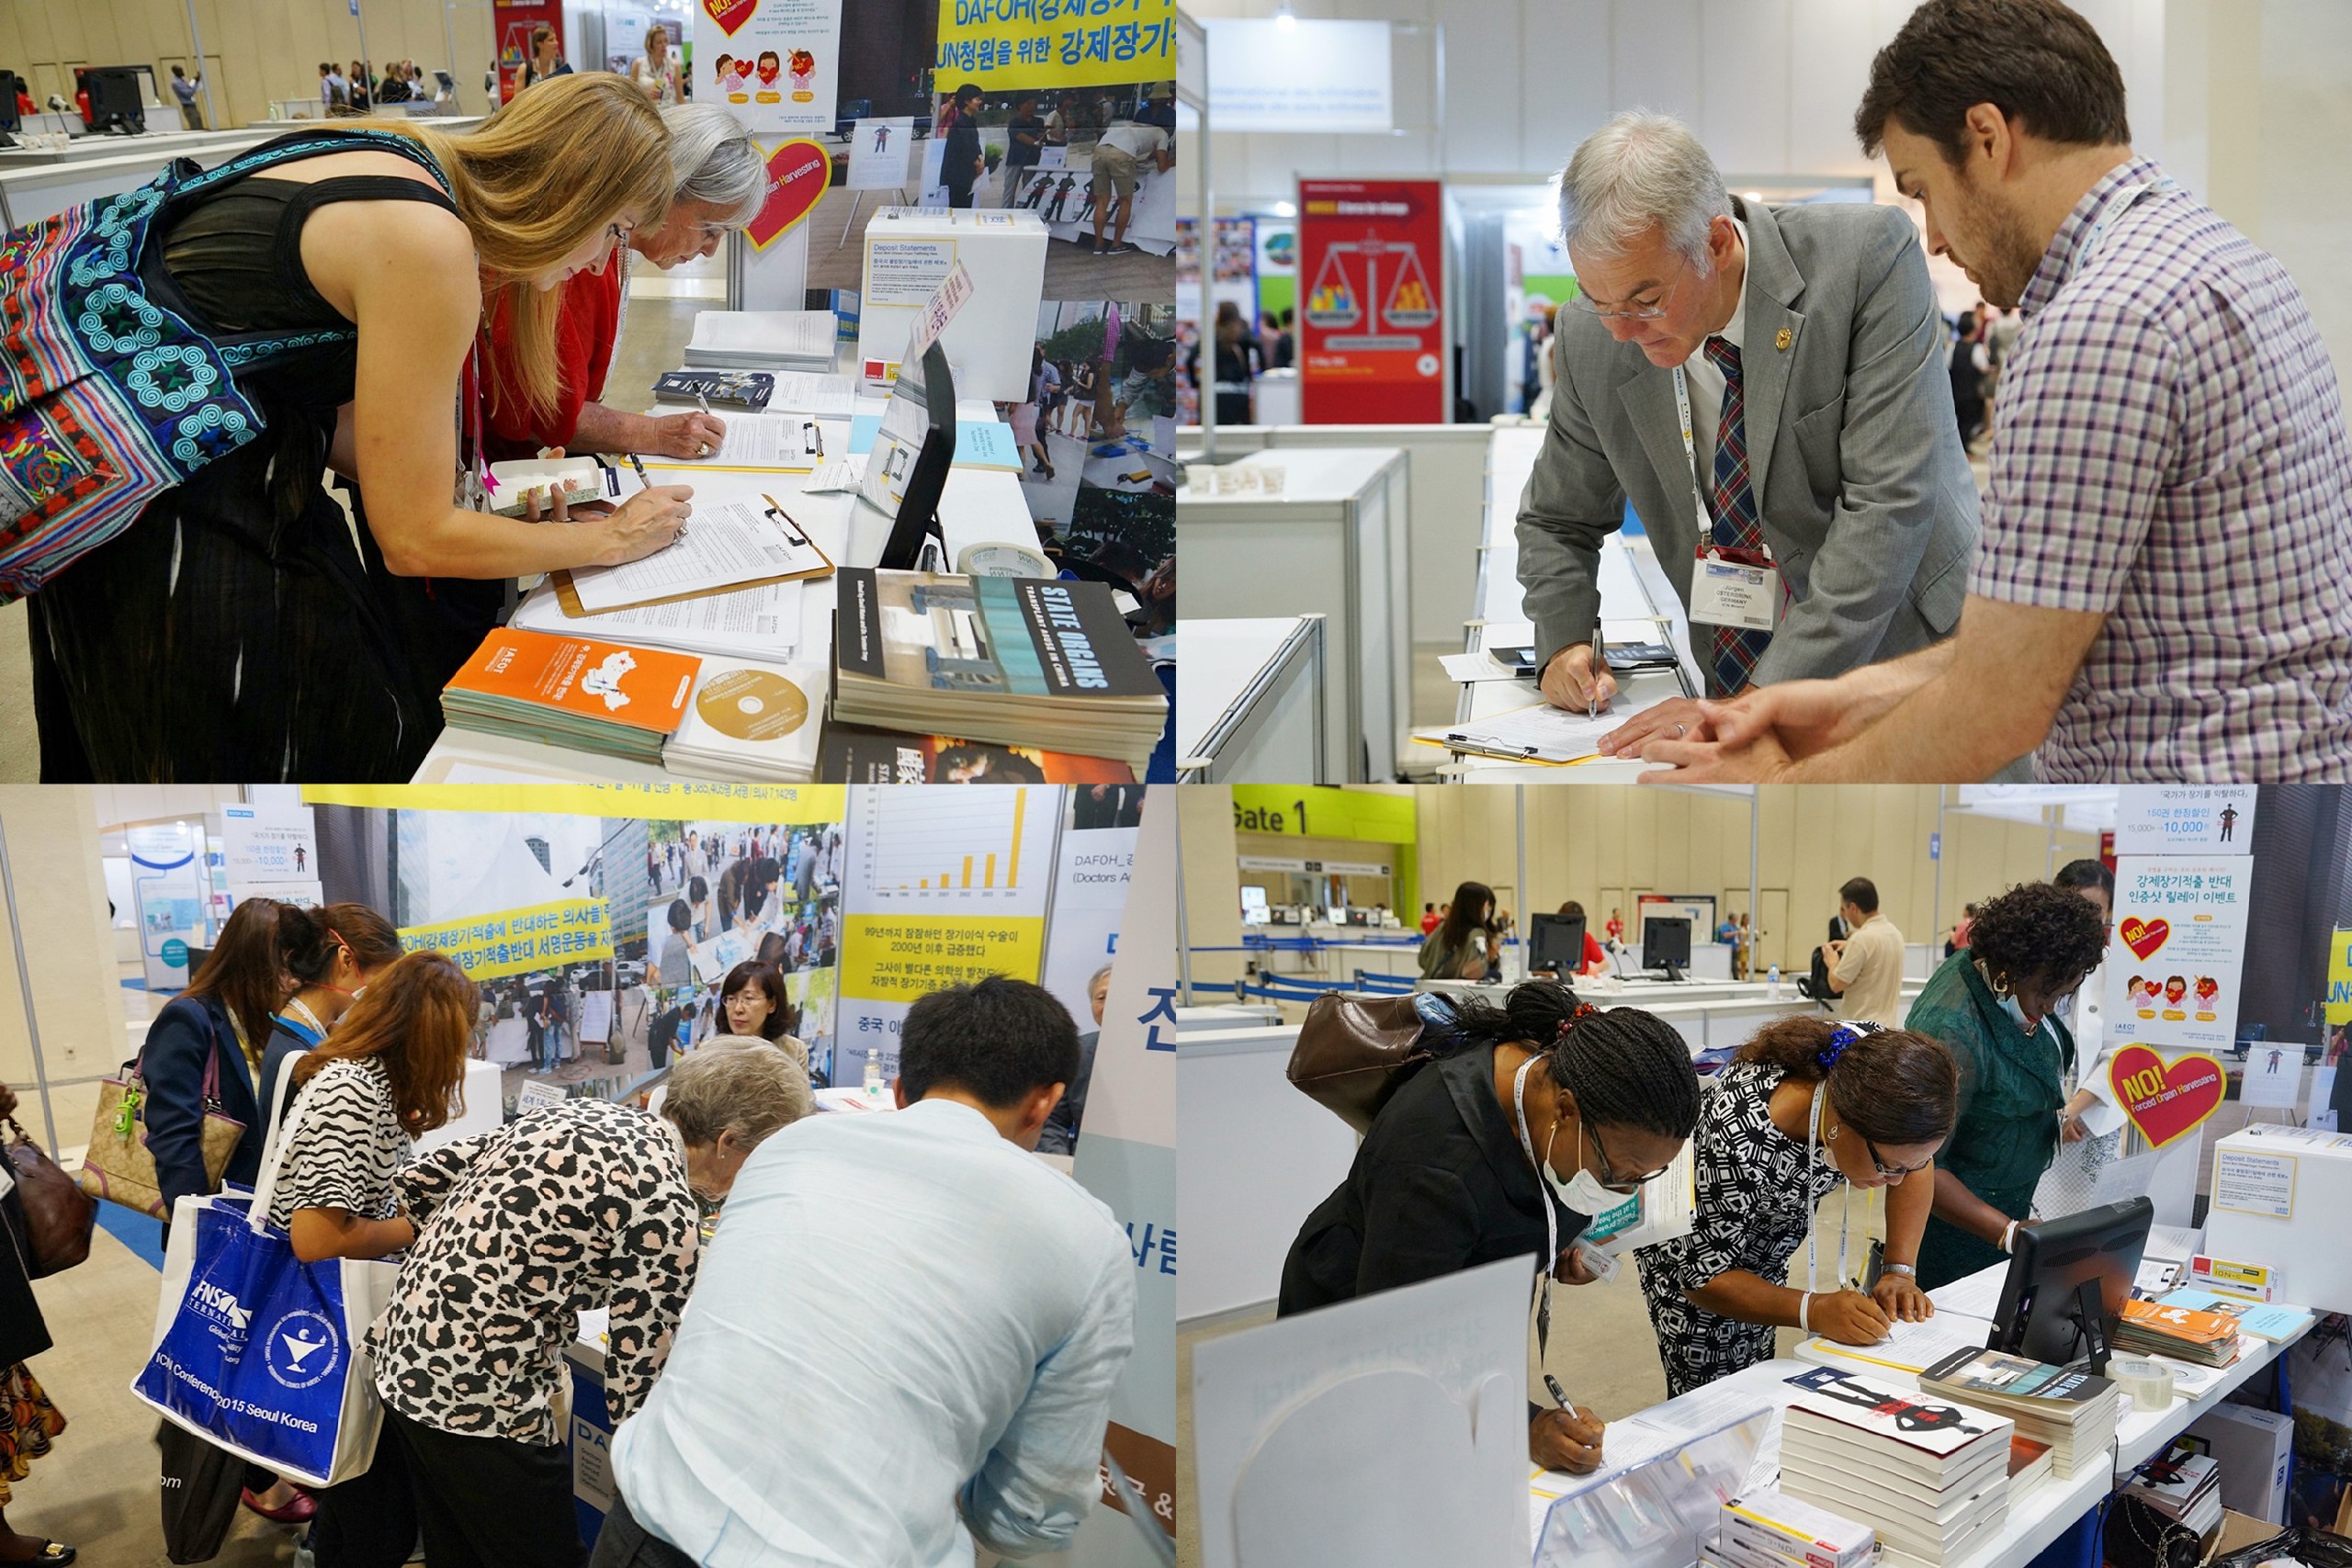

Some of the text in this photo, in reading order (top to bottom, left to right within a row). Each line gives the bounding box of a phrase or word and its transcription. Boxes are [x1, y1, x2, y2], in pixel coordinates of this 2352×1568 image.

[1016, 36, 1051, 63] 위한
[1058, 17, 1176, 66] 강제장기
[778, 159, 821, 186] Harvesting
[1041, 586, 1081, 629] STATE
[1057, 631, 1109, 689] ORGANS
[1294, 799, 1306, 835] 1
[1073, 872, 1117, 884] (Doctors
[2136, 874, 2233, 889] 강제장기적출 반대
[2128, 891, 2237, 904] 인증샷 릴레이 이벤트
[512, 911, 559, 934] 반대하는
[2125, 924, 2146, 942] NO!
[537, 930, 597, 956] 서명운동을
[865, 927, 1019, 942] 99년까지 잠잠하던 장기이식 수술이
[890, 942, 986, 957] 2000년 이후 급증했다
[875, 962, 901, 975] 그사이
[905, 963, 933, 976] 별다른
[935, 964, 963, 976] 의학의
[870, 976, 898, 987] 자발적
[2326, 980, 2352, 1003] UN
[858, 1016, 884, 1033] 중국
[2121, 1065, 2167, 1103] NO!
[2132, 1073, 2218, 1113] Forced Organ Harvesting
[155, 1352, 174, 1371] ICN
[245, 1402, 280, 1423] Seoul
[279, 1412, 318, 1434] Korea
[578, 1421, 608, 1453] DA
